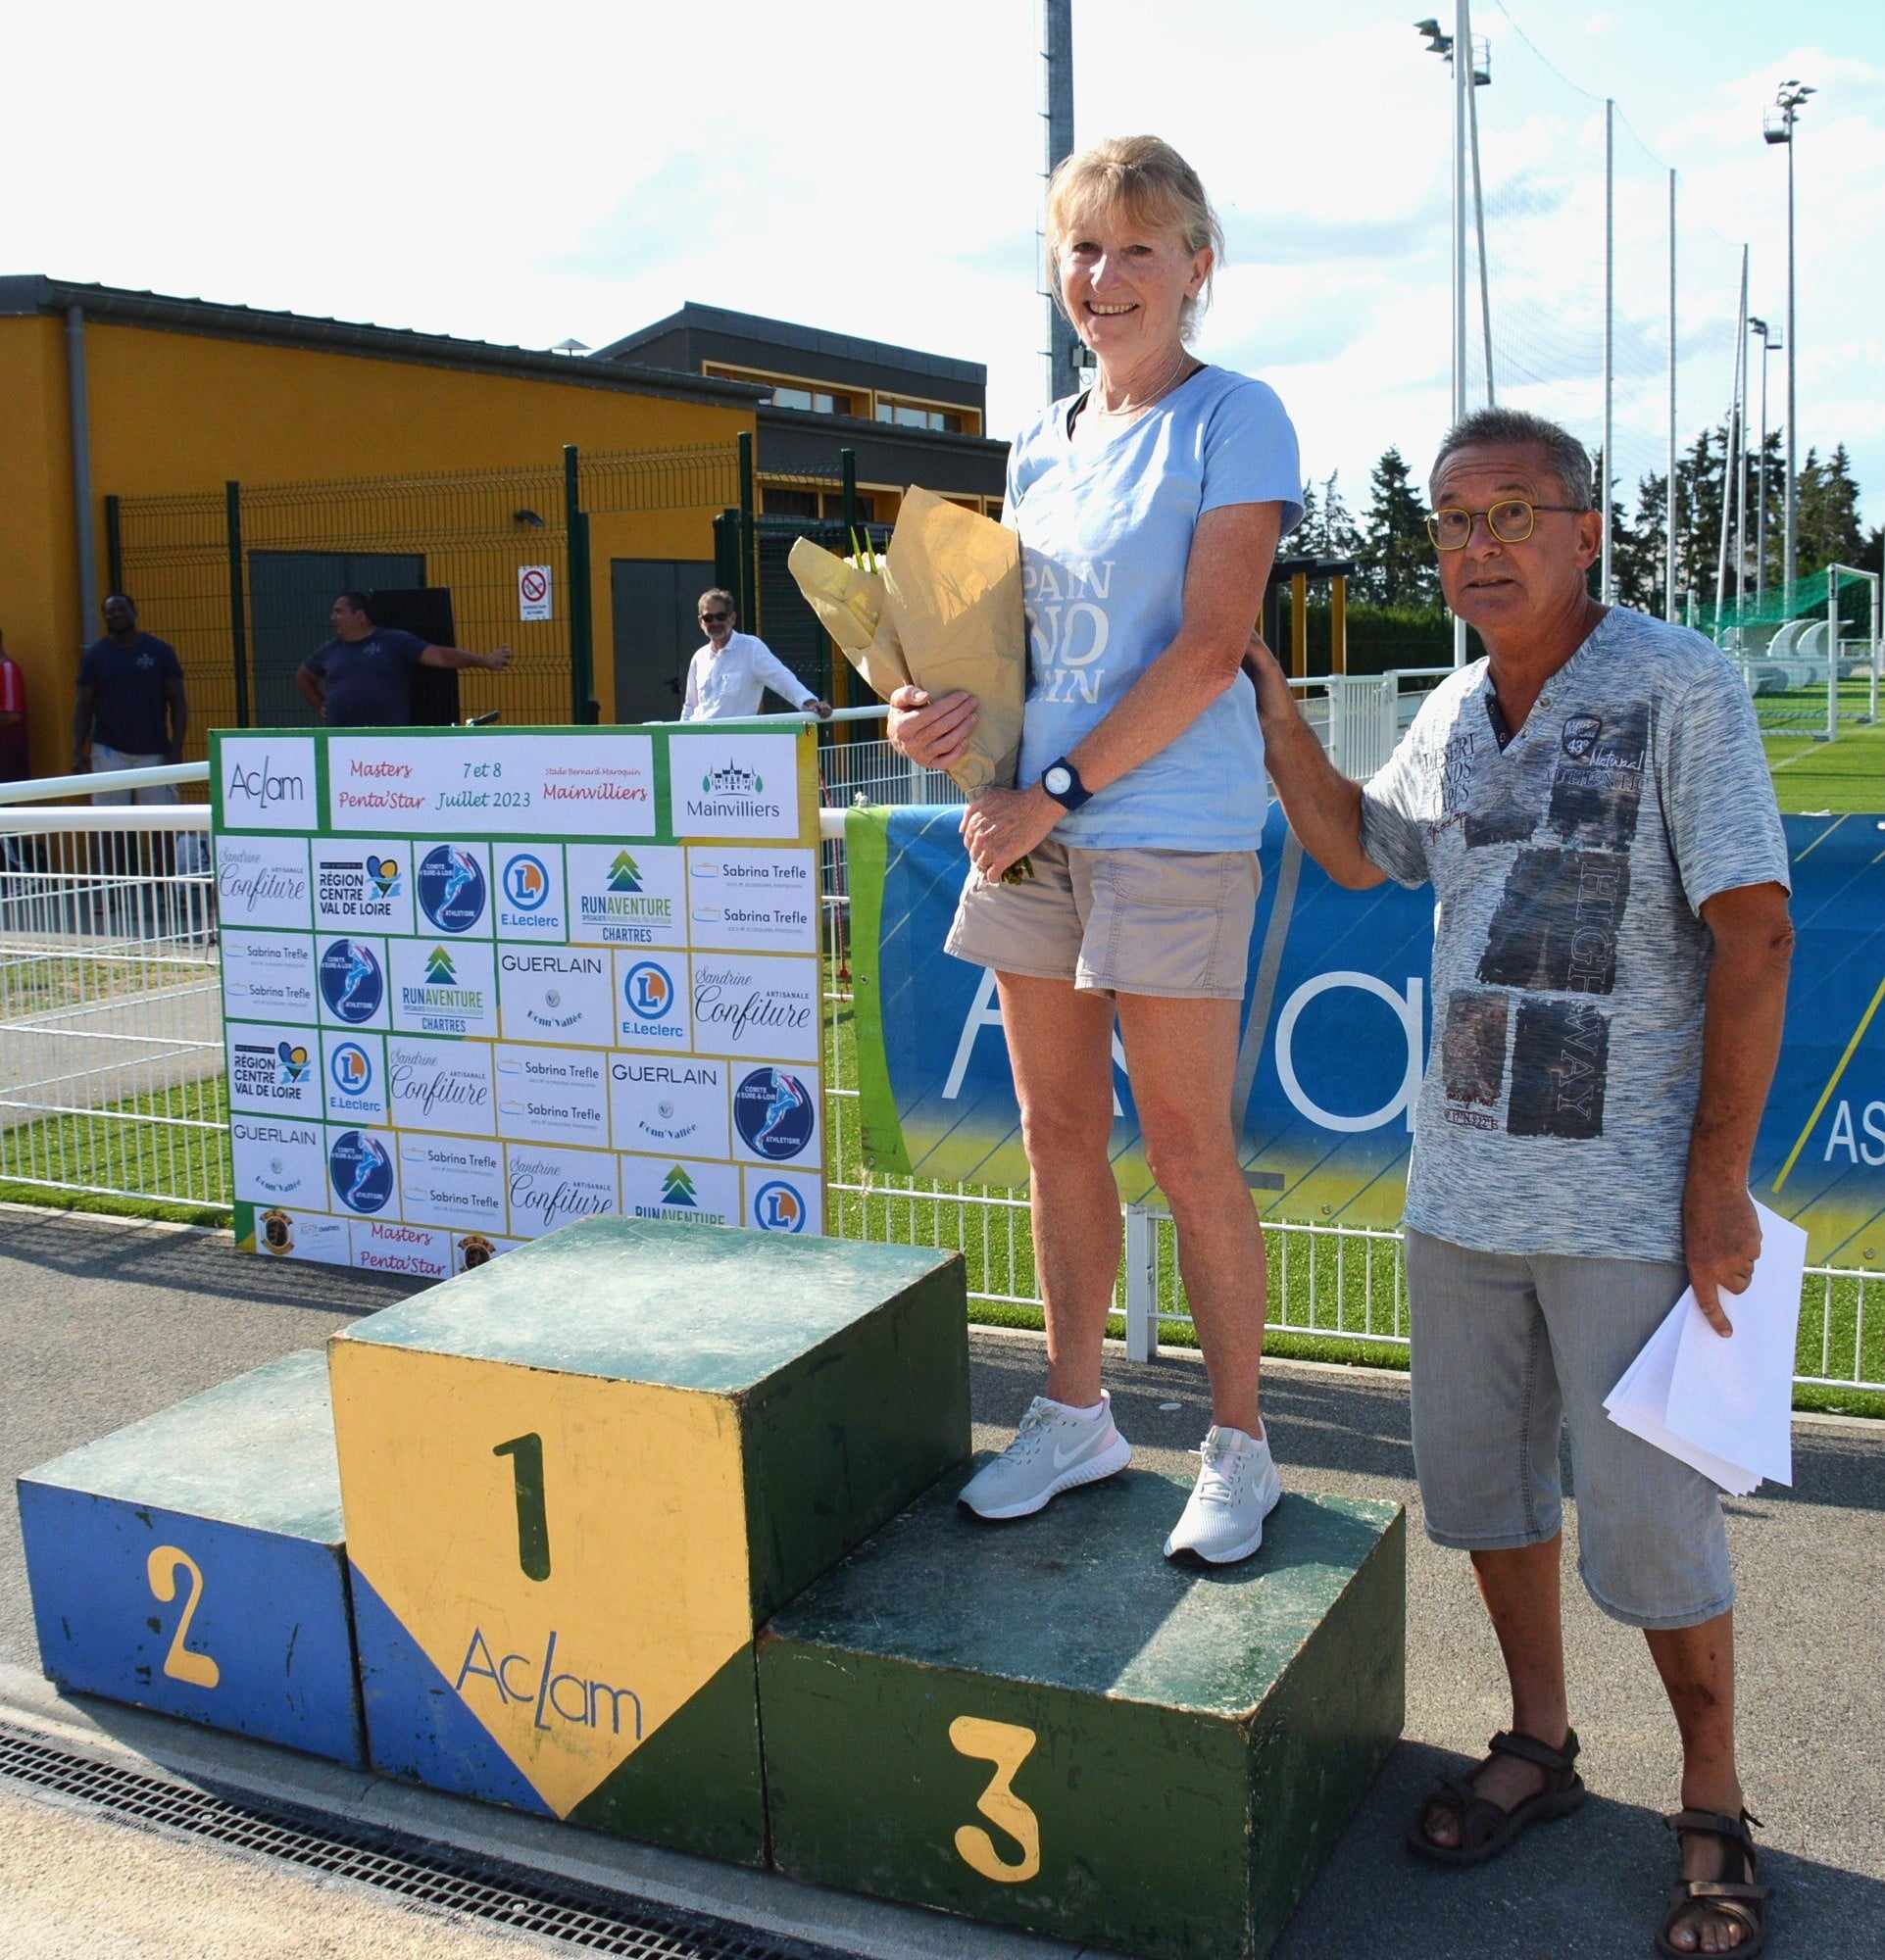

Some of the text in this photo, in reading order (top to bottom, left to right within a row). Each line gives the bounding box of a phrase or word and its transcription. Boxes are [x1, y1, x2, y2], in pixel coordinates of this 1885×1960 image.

[350, 760, 413, 778] Masters
[464, 762, 502, 778] 7 et 8
[338, 791, 425, 809] Penta'Star
[435, 791, 530, 811] Juillet 2023
[544, 783, 648, 802] Mainvilliers
[687, 801, 780, 817] Mainvilliers
[722, 863, 807, 879] Sabrina Trefle
[219, 863, 306, 912] Confiture
[320, 889, 363, 901] CENTRE
[320, 902, 391, 915] VAL DE LOIRE
[581, 896, 671, 916] RUNAVENTURE
[501, 914, 559, 927] E.Leclerc
[723, 908, 808, 924] Sabrina Trefle
[602, 927, 652, 943] CHARTRES
[247, 946, 309, 960] Sabrina Trefle
[502, 955, 602, 974] GUERLAIN
[695, 968, 753, 986] Sandrine
[249, 984, 311, 1000] Sabrina Trefle
[403, 987, 483, 1008] RUNAVENTURE
[766, 991, 810, 1000] ARTISANALE
[694, 985, 811, 1041] Confiture
[422, 1017, 466, 1033] CHARTRES
[622, 1022, 683, 1038] E.Leclerc
[234, 1069, 274, 1084] CENTRE
[525, 1061, 599, 1079] Sabrina Trefle
[612, 1063, 718, 1086] GUERLAIN
[234, 1082, 302, 1100] VAL DE LOIRE
[391, 1064, 488, 1116] Confiture
[329, 1097, 381, 1112] E.Leclerc
[527, 1102, 601, 1121] Sabrina Trefle
[234, 1124, 316, 1145] GUERLAIN
[427, 1151, 496, 1168] Sabrina Trefle
[510, 1155, 561, 1176] Sandrine
[429, 1190, 499, 1208] Sabrina Trefle
[372, 1222, 433, 1246] Masters
[361, 1250, 446, 1276] Penta'Star
[492, 1432, 552, 1582] 1
[147, 1545, 220, 1689] 2
[948, 1715, 1041, 1883] 3
